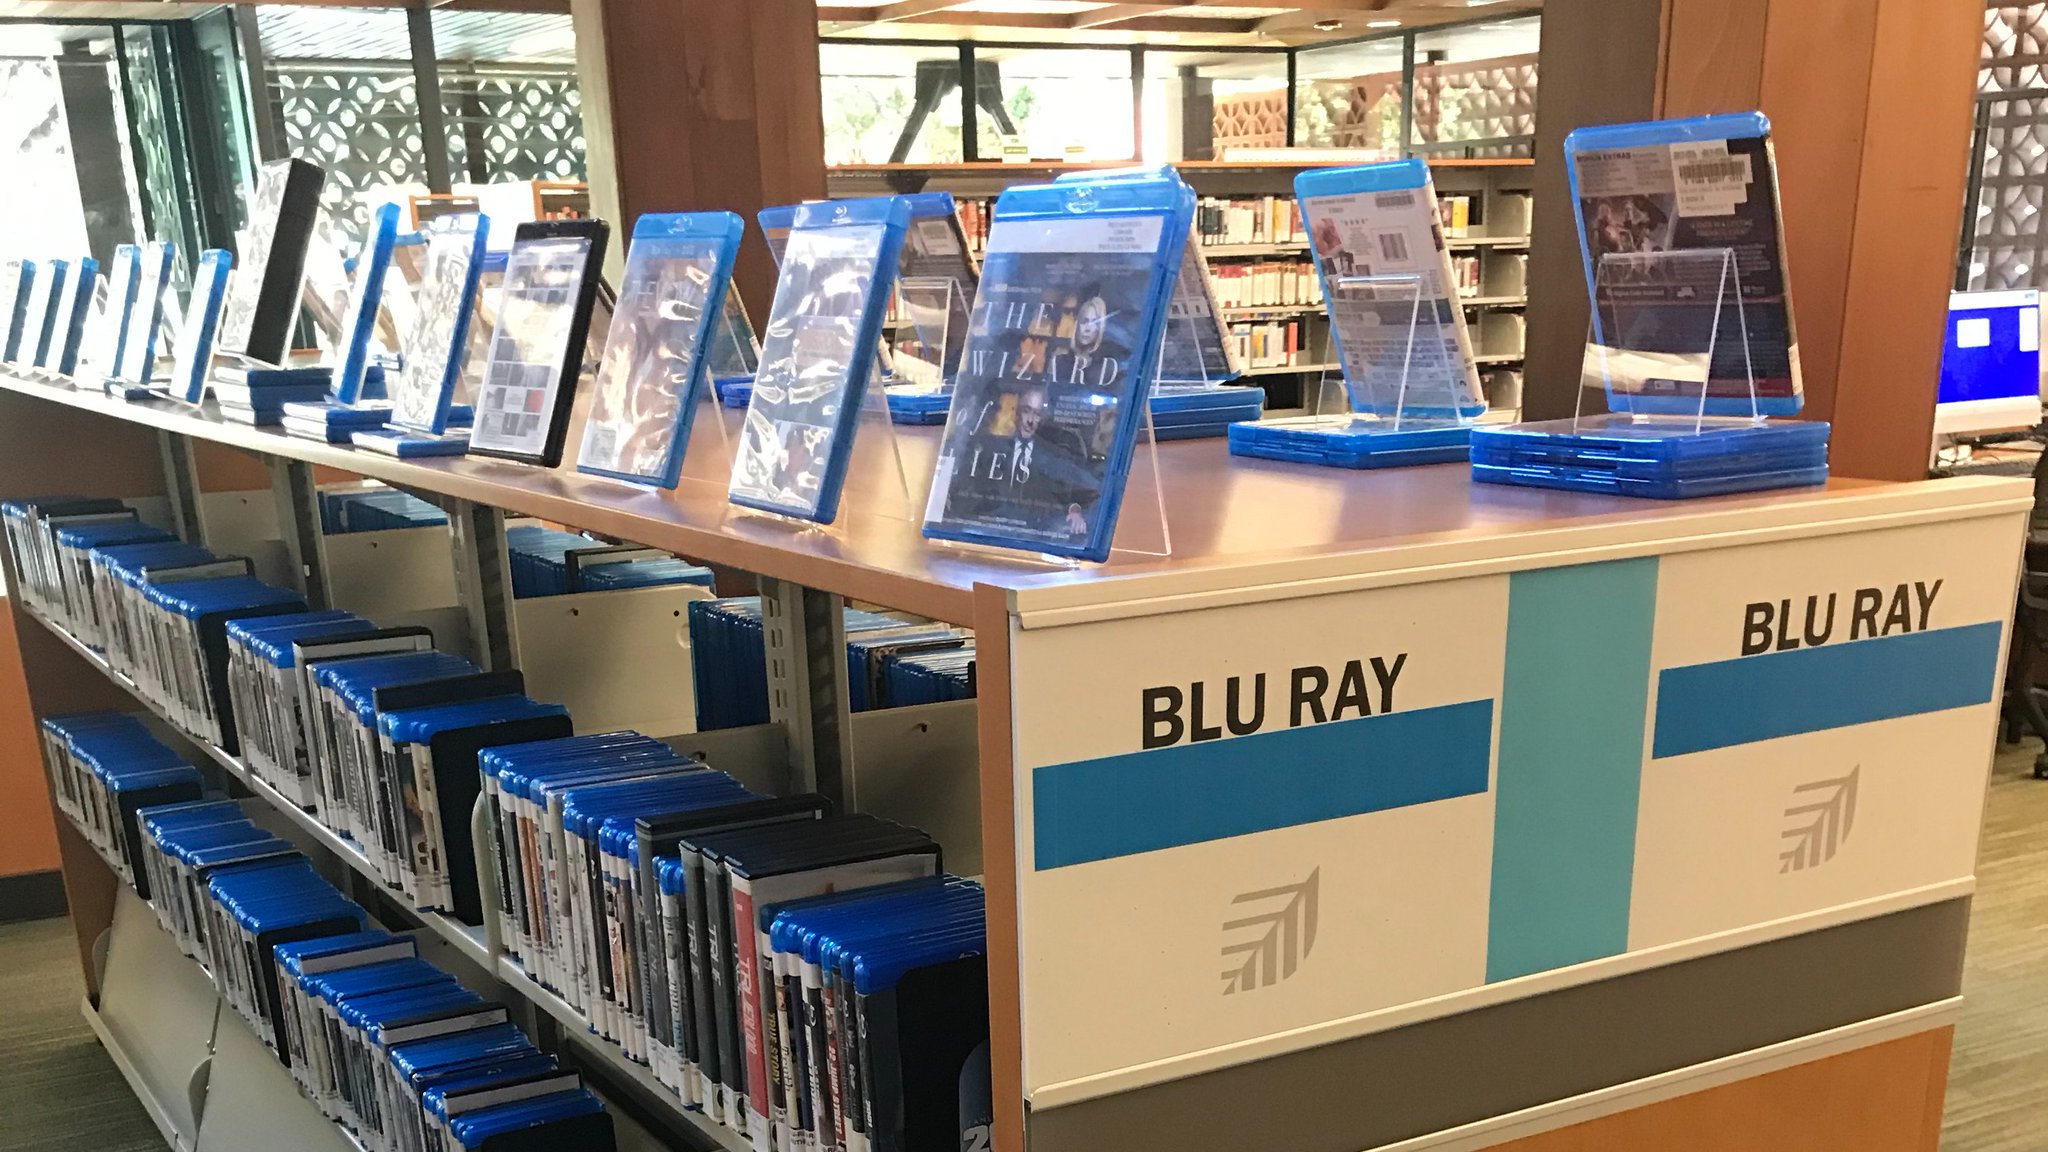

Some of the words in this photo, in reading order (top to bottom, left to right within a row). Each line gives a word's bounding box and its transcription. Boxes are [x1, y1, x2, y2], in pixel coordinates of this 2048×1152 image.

[980, 301, 1054, 329] THE
[972, 350, 1119, 386] WIZARD
[955, 400, 993, 436] of
[1741, 592, 1837, 657] BLU
[1849, 579, 1944, 641] RAY
[1142, 672, 1266, 750] BLU
[1289, 653, 1408, 728] RAY
[767, 1011, 778, 1043] TRUE
[770, 1047, 781, 1085] STORY
[781, 1047, 793, 1092] Truth
[828, 1045, 837, 1062] 22
[830, 1064, 839, 1094] JUMP
[832, 1095, 843, 1134] STREET
